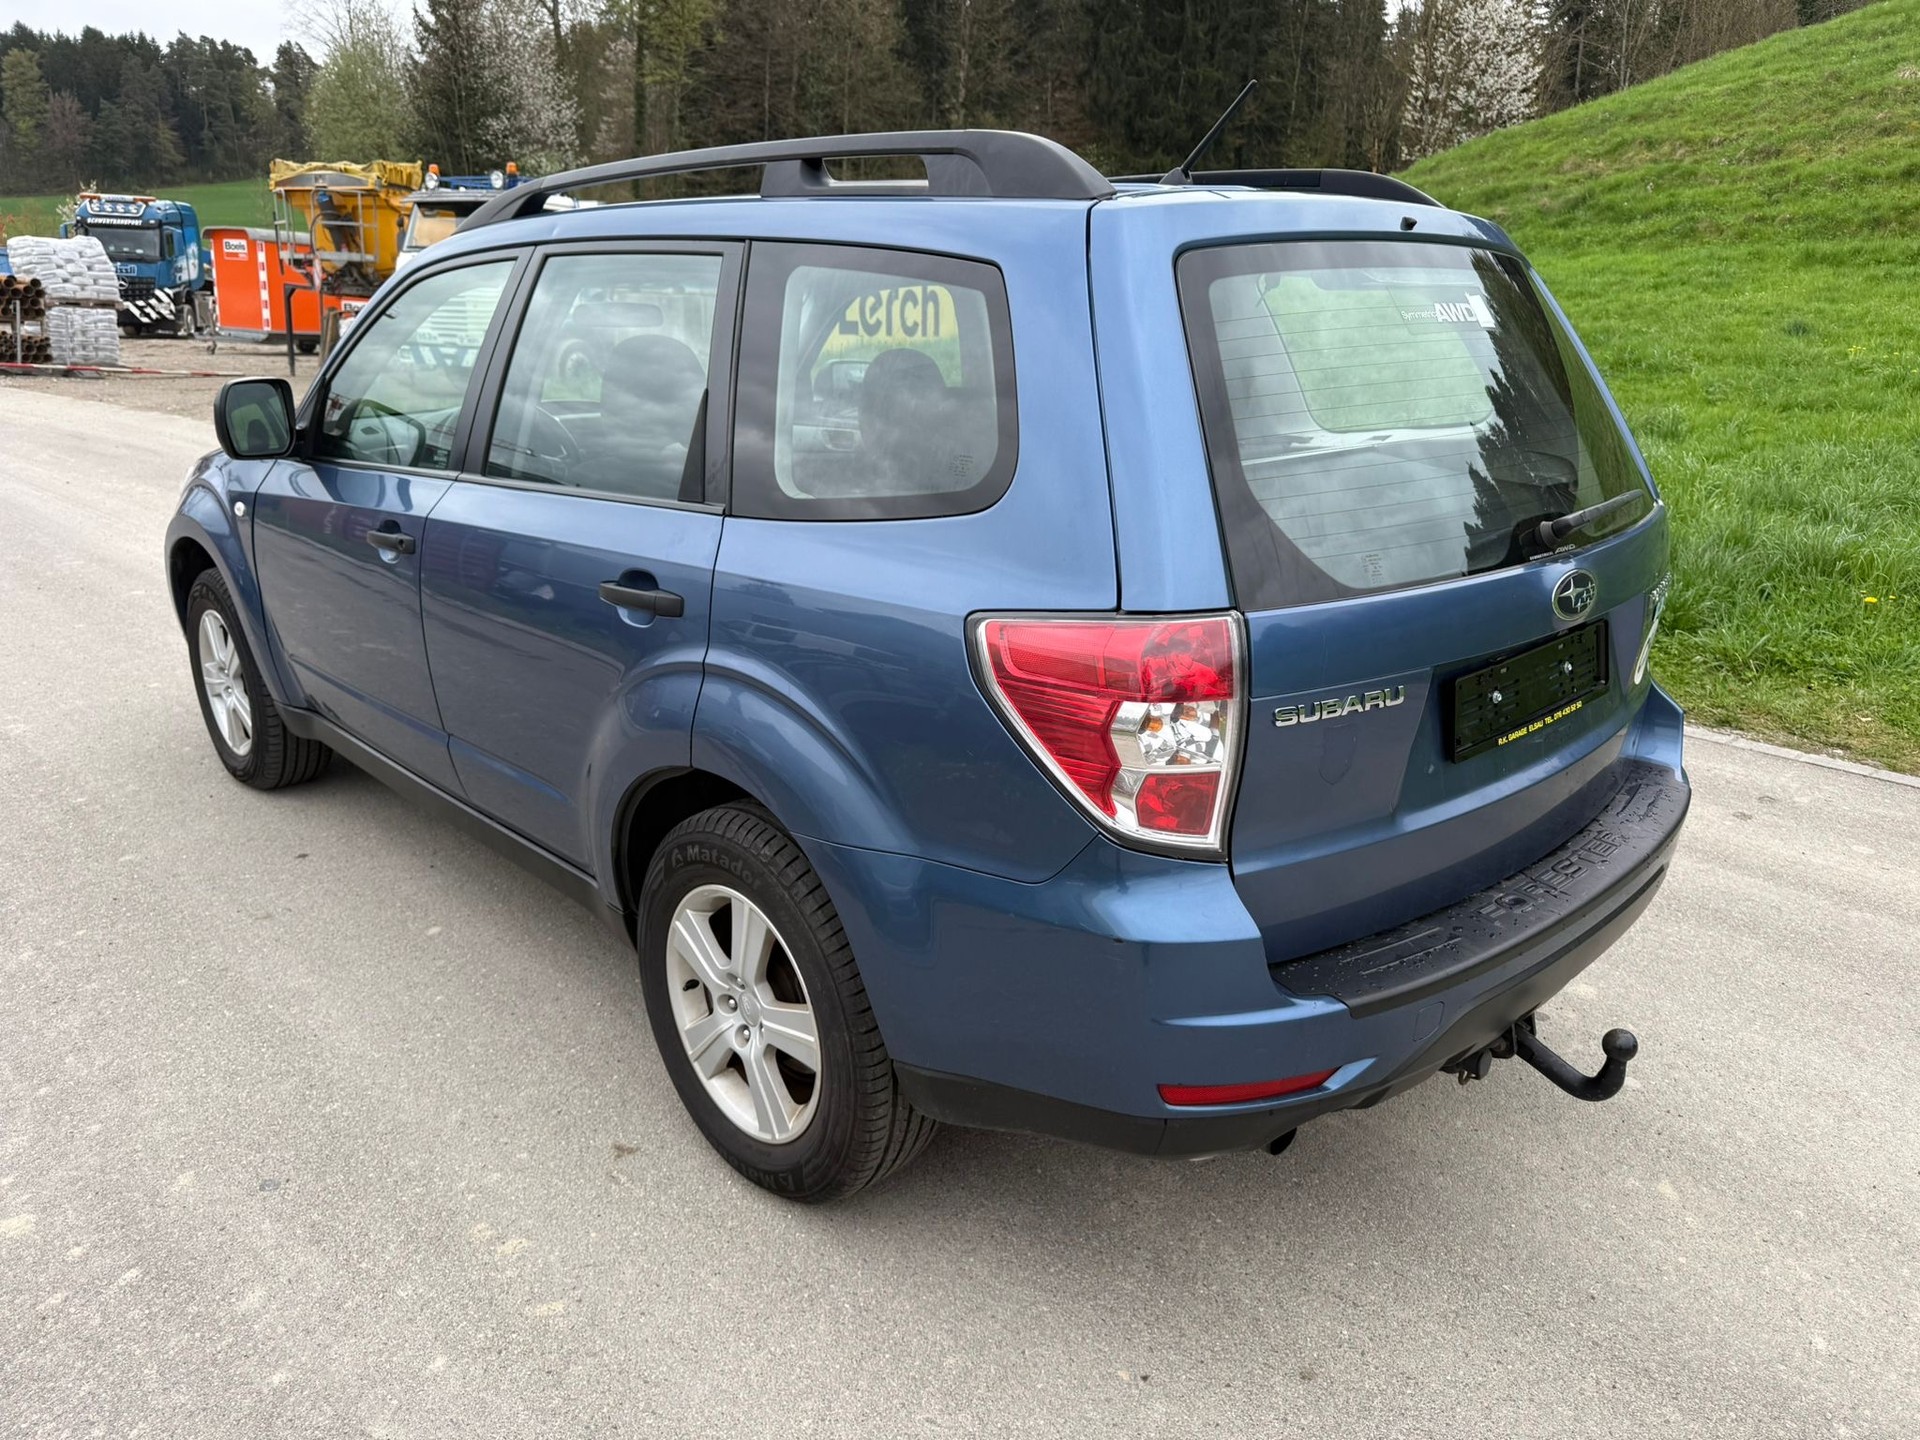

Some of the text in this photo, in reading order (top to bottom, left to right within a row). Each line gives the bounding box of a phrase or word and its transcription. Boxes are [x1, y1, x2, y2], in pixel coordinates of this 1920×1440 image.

[224, 241, 246, 252] Boels
[1433, 302, 1478, 323] AWD
[1273, 685, 1405, 728] SUBARU
[1508, 727, 1527, 741] GARAGE
[686, 845, 761, 890] Matador
